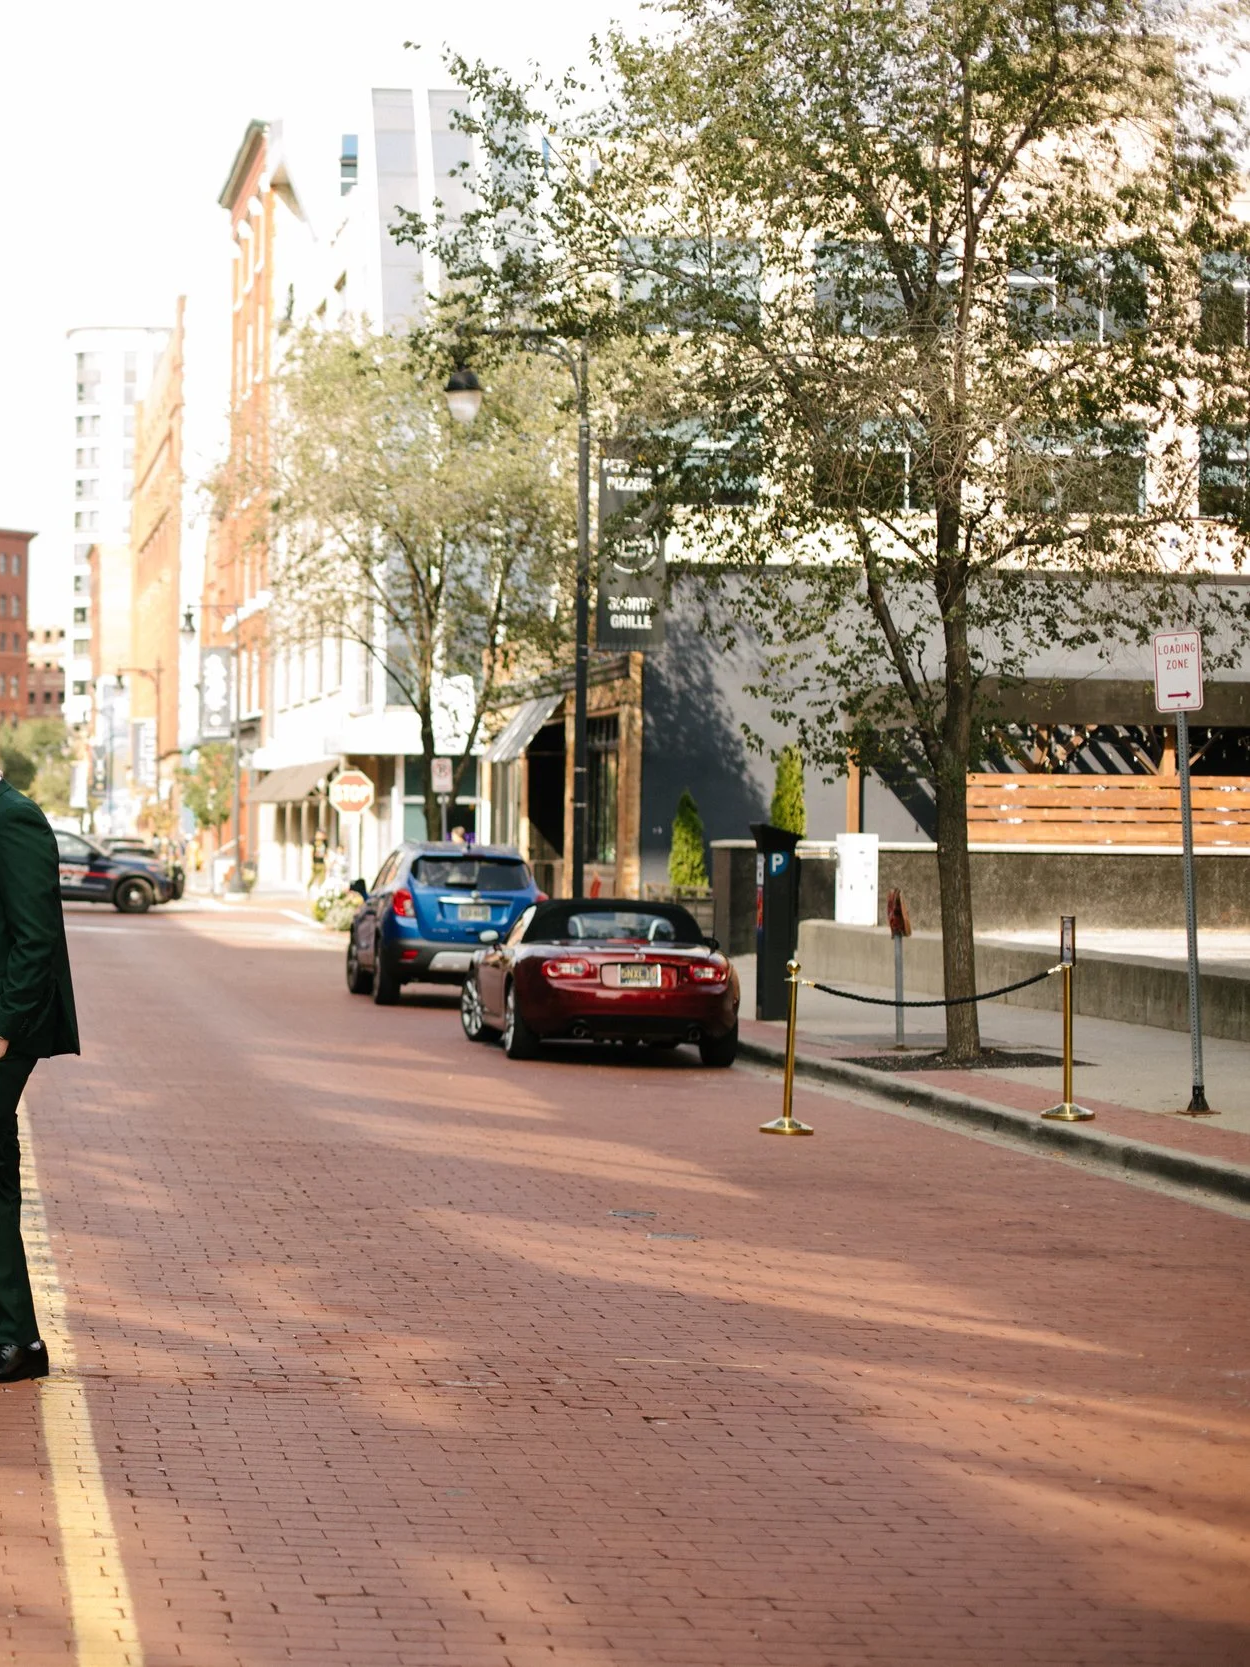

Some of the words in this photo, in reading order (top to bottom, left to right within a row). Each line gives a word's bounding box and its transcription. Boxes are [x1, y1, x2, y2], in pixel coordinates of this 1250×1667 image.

[610, 614, 652, 630] GRILLE
[1158, 643, 1196, 655] LOADING
[1166, 658, 1189, 670] ZONE
[333, 784, 371, 803] STOP
[772, 853, 784, 873] P
